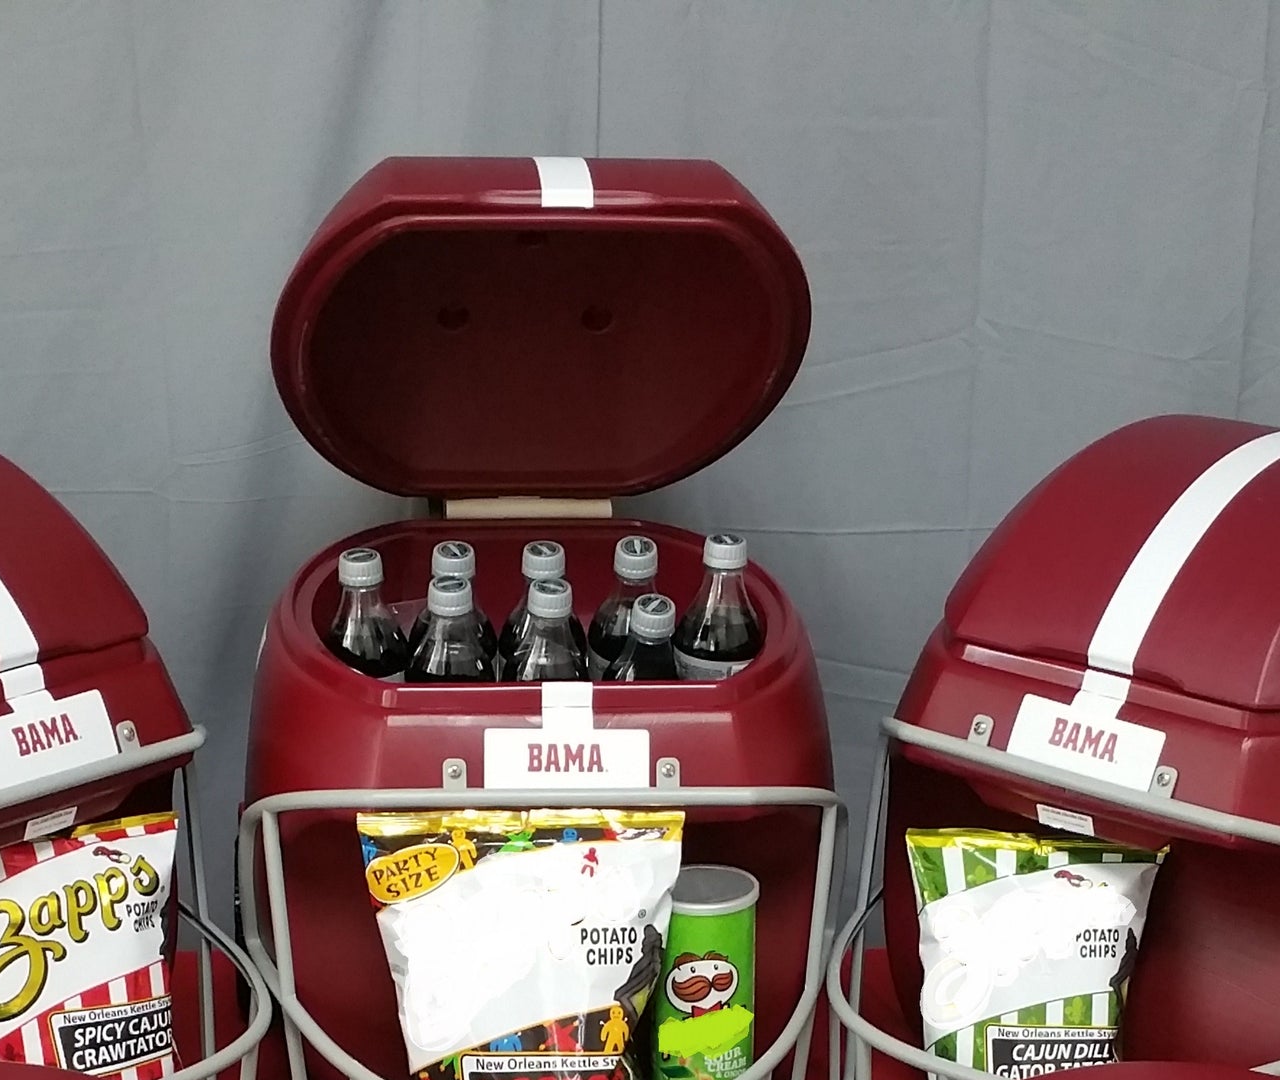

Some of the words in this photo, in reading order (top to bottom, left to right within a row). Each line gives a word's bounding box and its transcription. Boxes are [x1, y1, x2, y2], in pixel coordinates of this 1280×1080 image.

[12, 713, 78, 757] BAMA
[1048, 717, 1118, 762] BAMA
[527, 743, 604, 772] BAMA
[372, 848, 438, 885] PARTY
[386, 865, 440, 897] SIZE
[581, 927, 637, 944] POTATO
[586, 947, 633, 965] CHIPS
[1080, 945, 1116, 958] CHIPS
[63, 1015, 86, 1025] New
[89, 1008, 128, 1020] Orleans
[130, 1003, 156, 1014] Kettle
[74, 1021, 125, 1048] SPICY
[997, 1028, 1020, 1038] New
[1022, 1028, 1061, 1038] Orleans
[1064, 1028, 1095, 1038] Kettle
[1012, 1043, 1072, 1061] CAJUN
[1074, 1043, 1110, 1059] DILL
[476, 1058, 504, 1071] New
[507, 1057, 558, 1070] Orleans
[561, 1056, 599, 1069] Kettle
